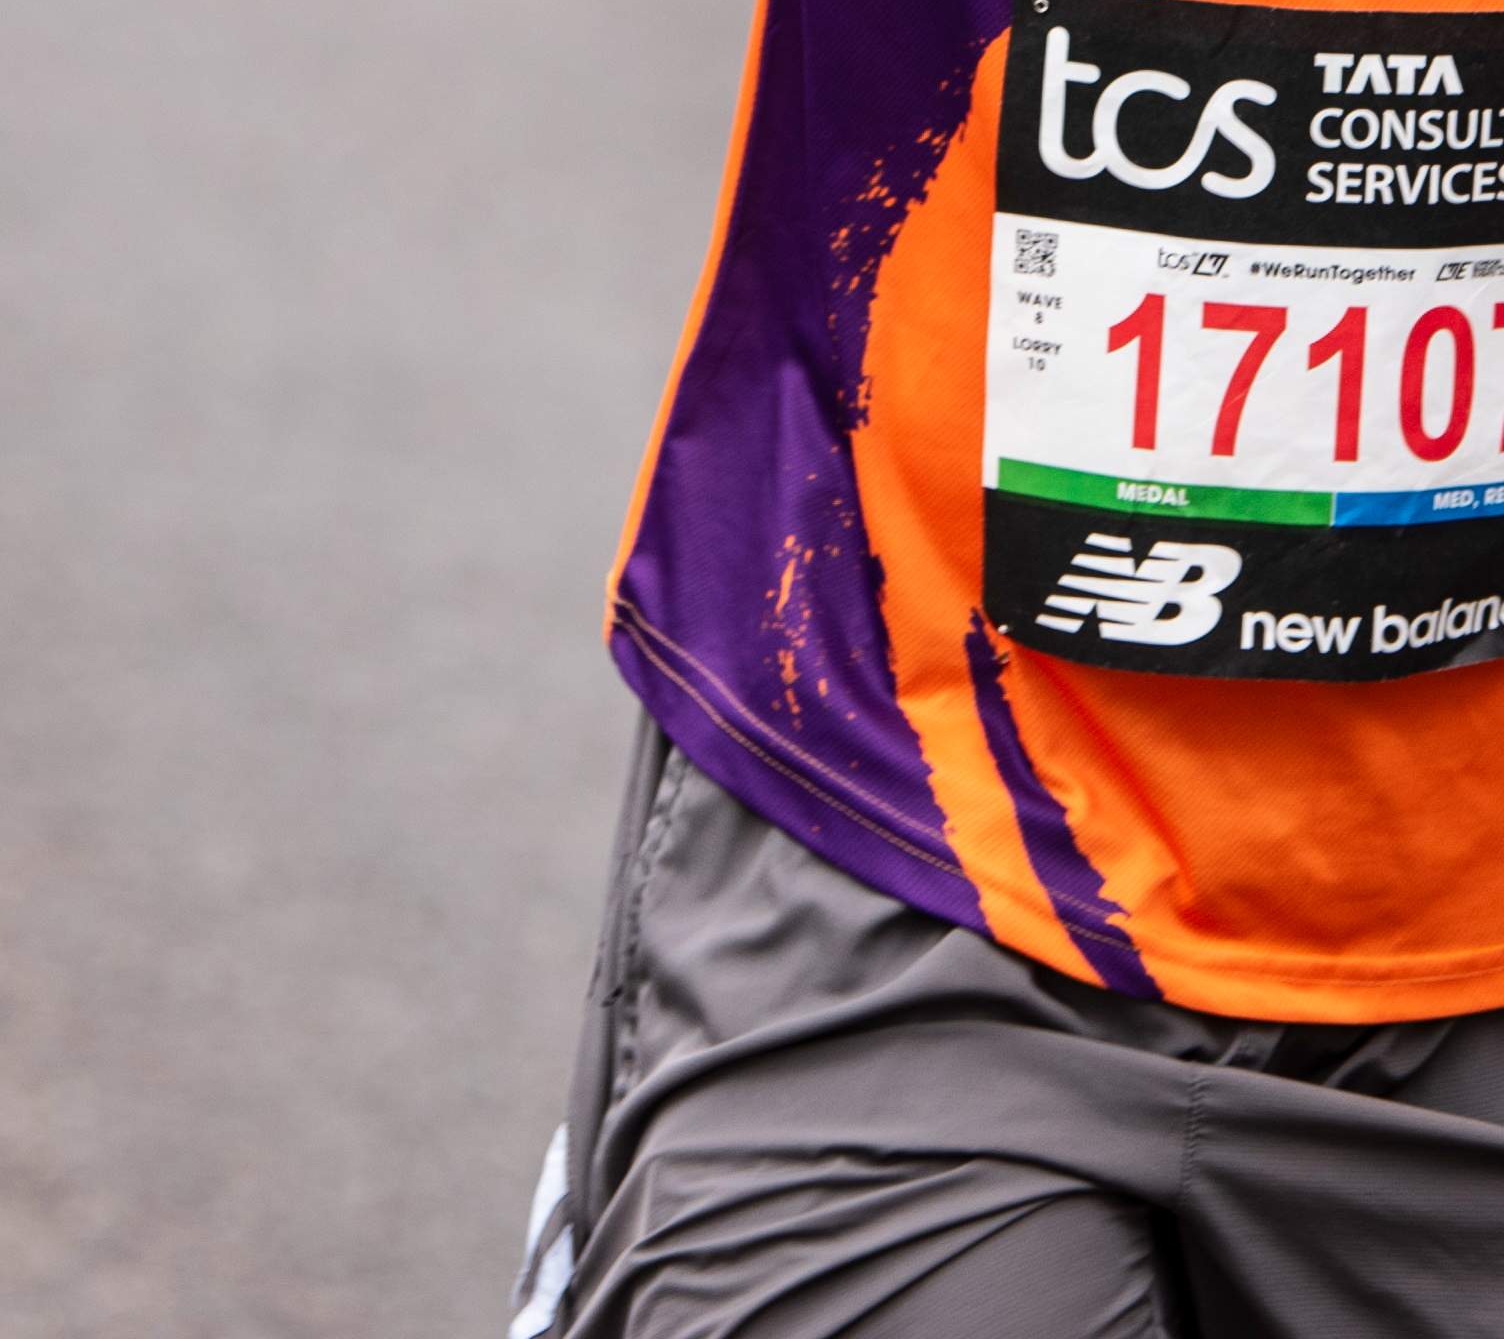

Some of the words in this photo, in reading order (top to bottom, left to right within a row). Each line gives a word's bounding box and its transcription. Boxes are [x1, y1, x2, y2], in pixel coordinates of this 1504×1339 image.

[1313, 52, 1464, 95] TATA
[1039, 26, 1278, 199] tcs
[1250, 261, 1416, 284] #WeRunTogether
[1017, 291, 1063, 310] WAVE
[1117, 481, 1191, 506] MEDAL
[1432, 489, 1479, 510] MED,
[1240, 610, 1361, 654] new
